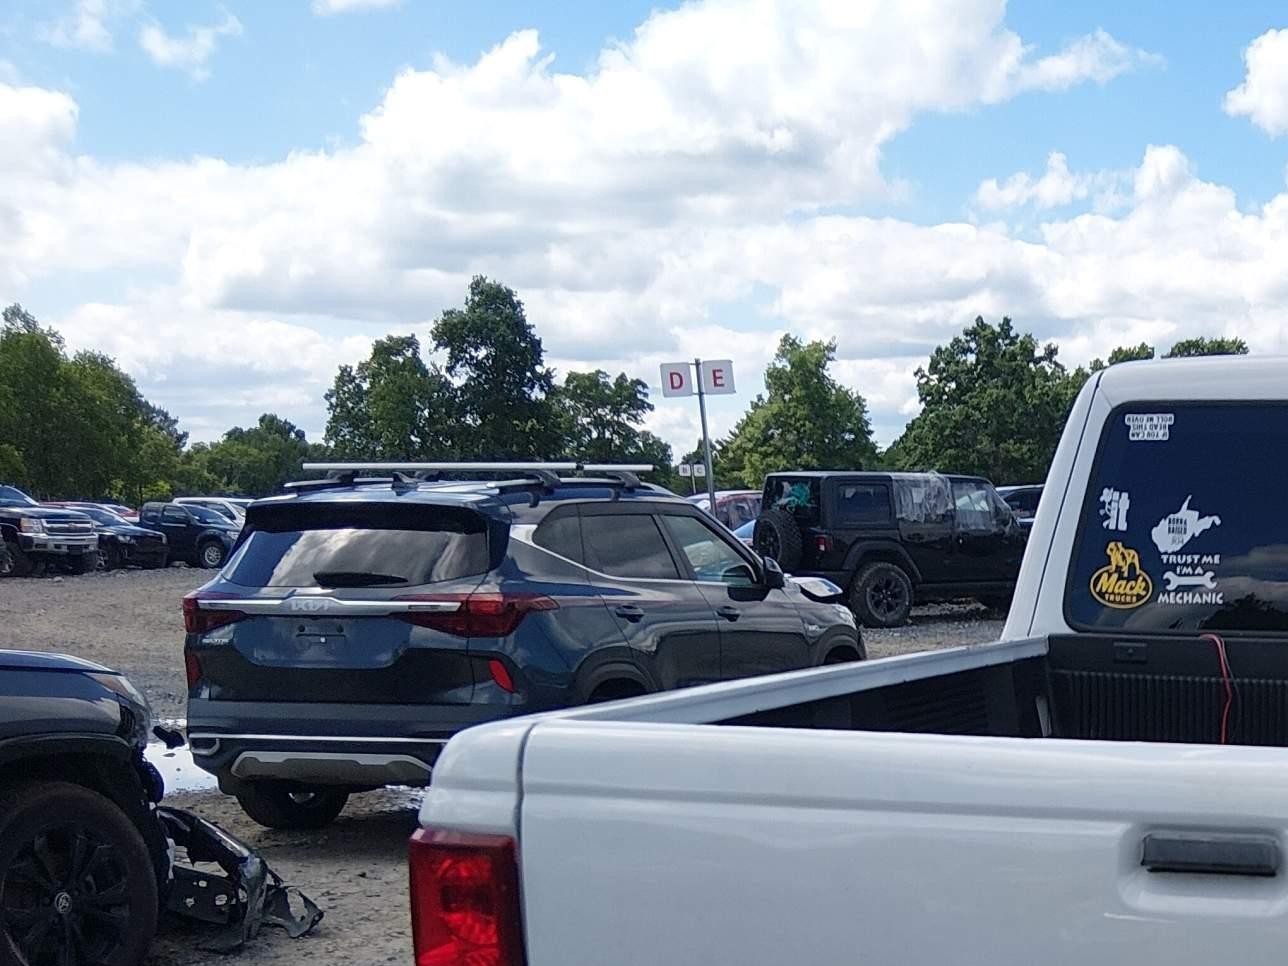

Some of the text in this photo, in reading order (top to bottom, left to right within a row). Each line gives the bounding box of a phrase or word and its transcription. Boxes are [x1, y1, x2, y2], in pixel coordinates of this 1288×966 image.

[669, 372, 684, 390] D
[712, 369, 725, 387] E
[1161, 554, 1220, 564] TRUST ME
[1176, 565, 1204, 575] I'M A
[1095, 572, 1147, 595] Mack
[1104, 594, 1138, 603] TRUCKS
[1158, 592, 1224, 604] MECHANIC
